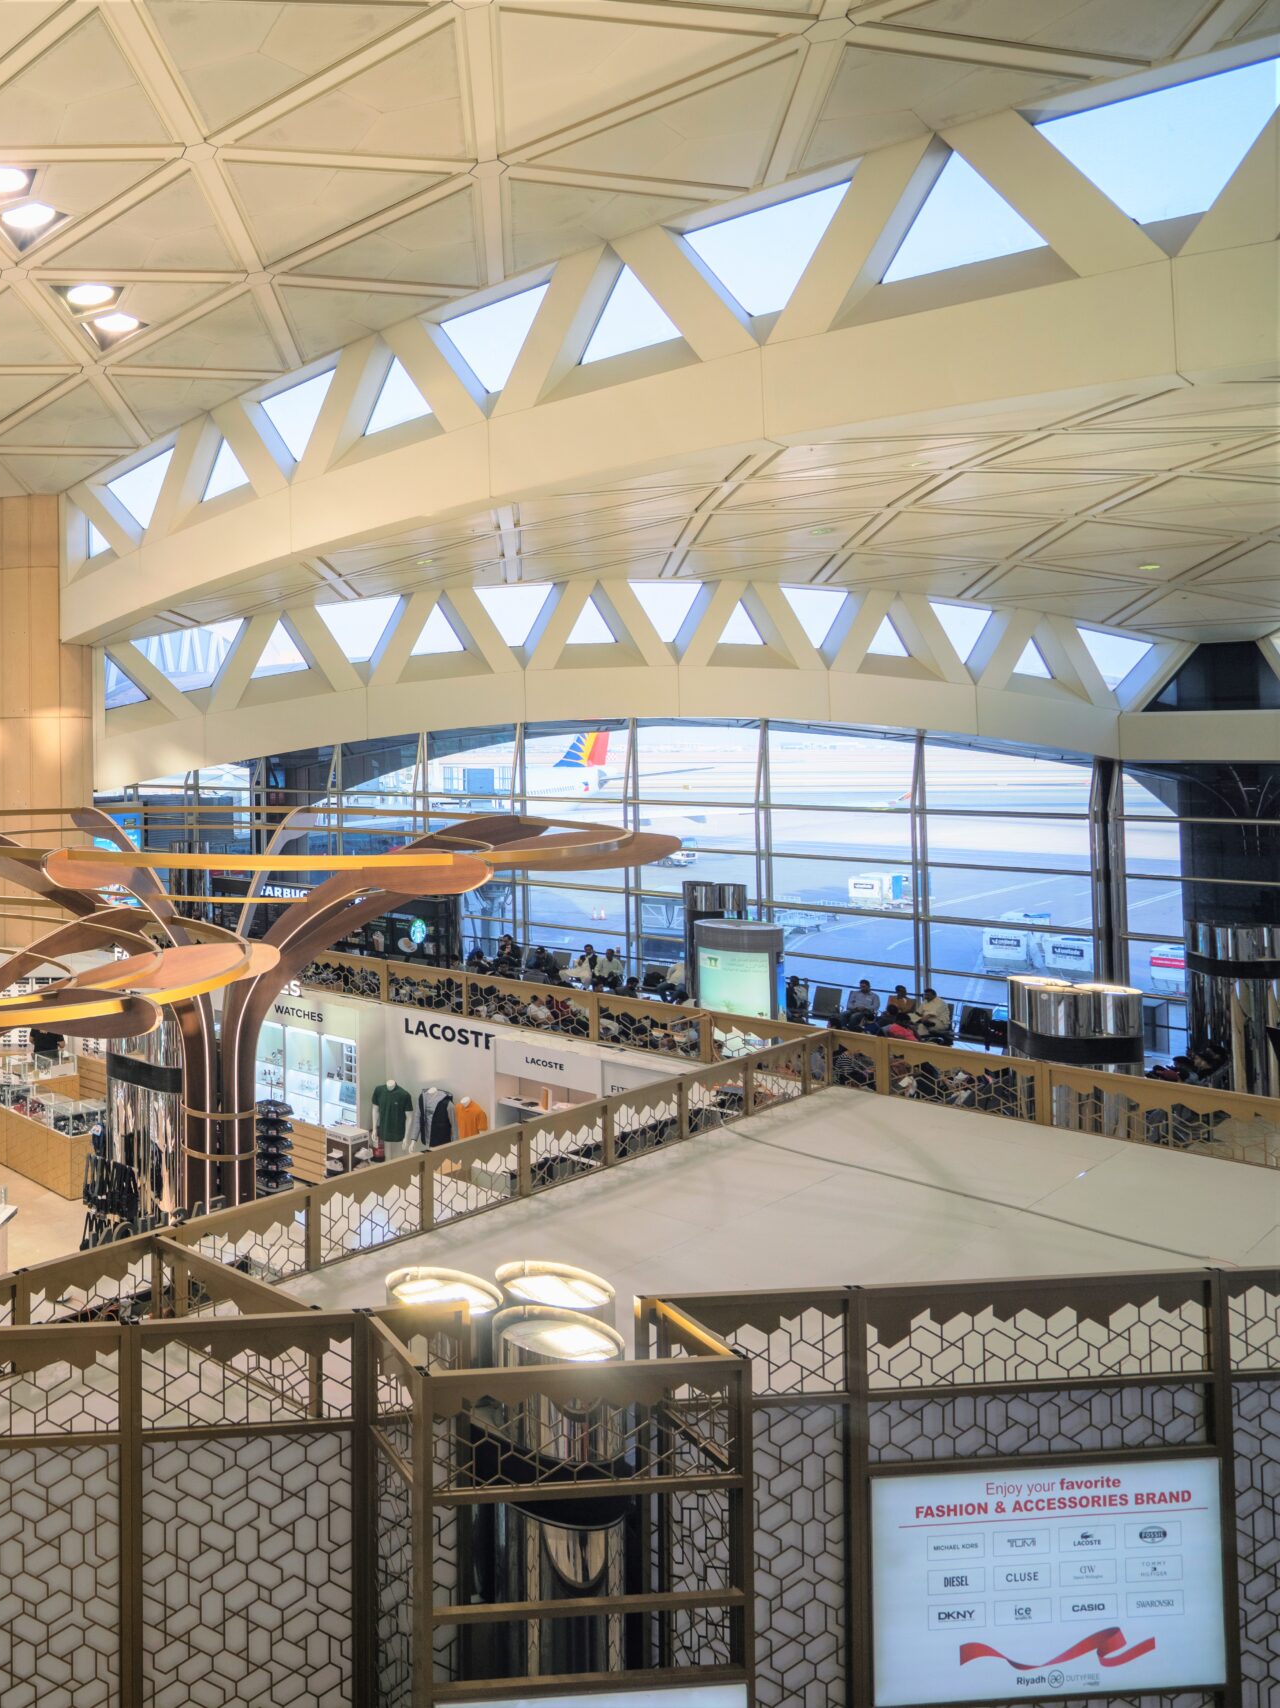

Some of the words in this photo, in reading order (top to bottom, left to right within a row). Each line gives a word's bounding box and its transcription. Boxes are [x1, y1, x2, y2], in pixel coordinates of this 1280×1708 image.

[260, 885, 309, 898] TARBUC
[274, 1005, 324, 1023] WATCHES
[525, 1056, 565, 1071] LACOSTE
[986, 1482, 1023, 1498] Enjoy
[1027, 1481, 1056, 1496] your
[1060, 1476, 1121, 1491] favorite
[915, 1502, 988, 1519] FASHION
[994, 1501, 1006, 1513] &
[1012, 1494, 1128, 1513] ACCESSORIES
[1134, 1490, 1192, 1505] BRAND
[1073, 1539, 1101, 1547] LACOSTE
[944, 1576, 969, 1588] DIESEL
[1006, 1572, 1039, 1582] CLUSE
[1072, 1603, 1105, 1612] CASIO
[1136, 1599, 1175, 1608] SWAROVSKI
[938, 1610, 975, 1621] DKNY
[1014, 1604, 1032, 1616] ice
[1016, 1675, 1046, 1687] Riyadh
